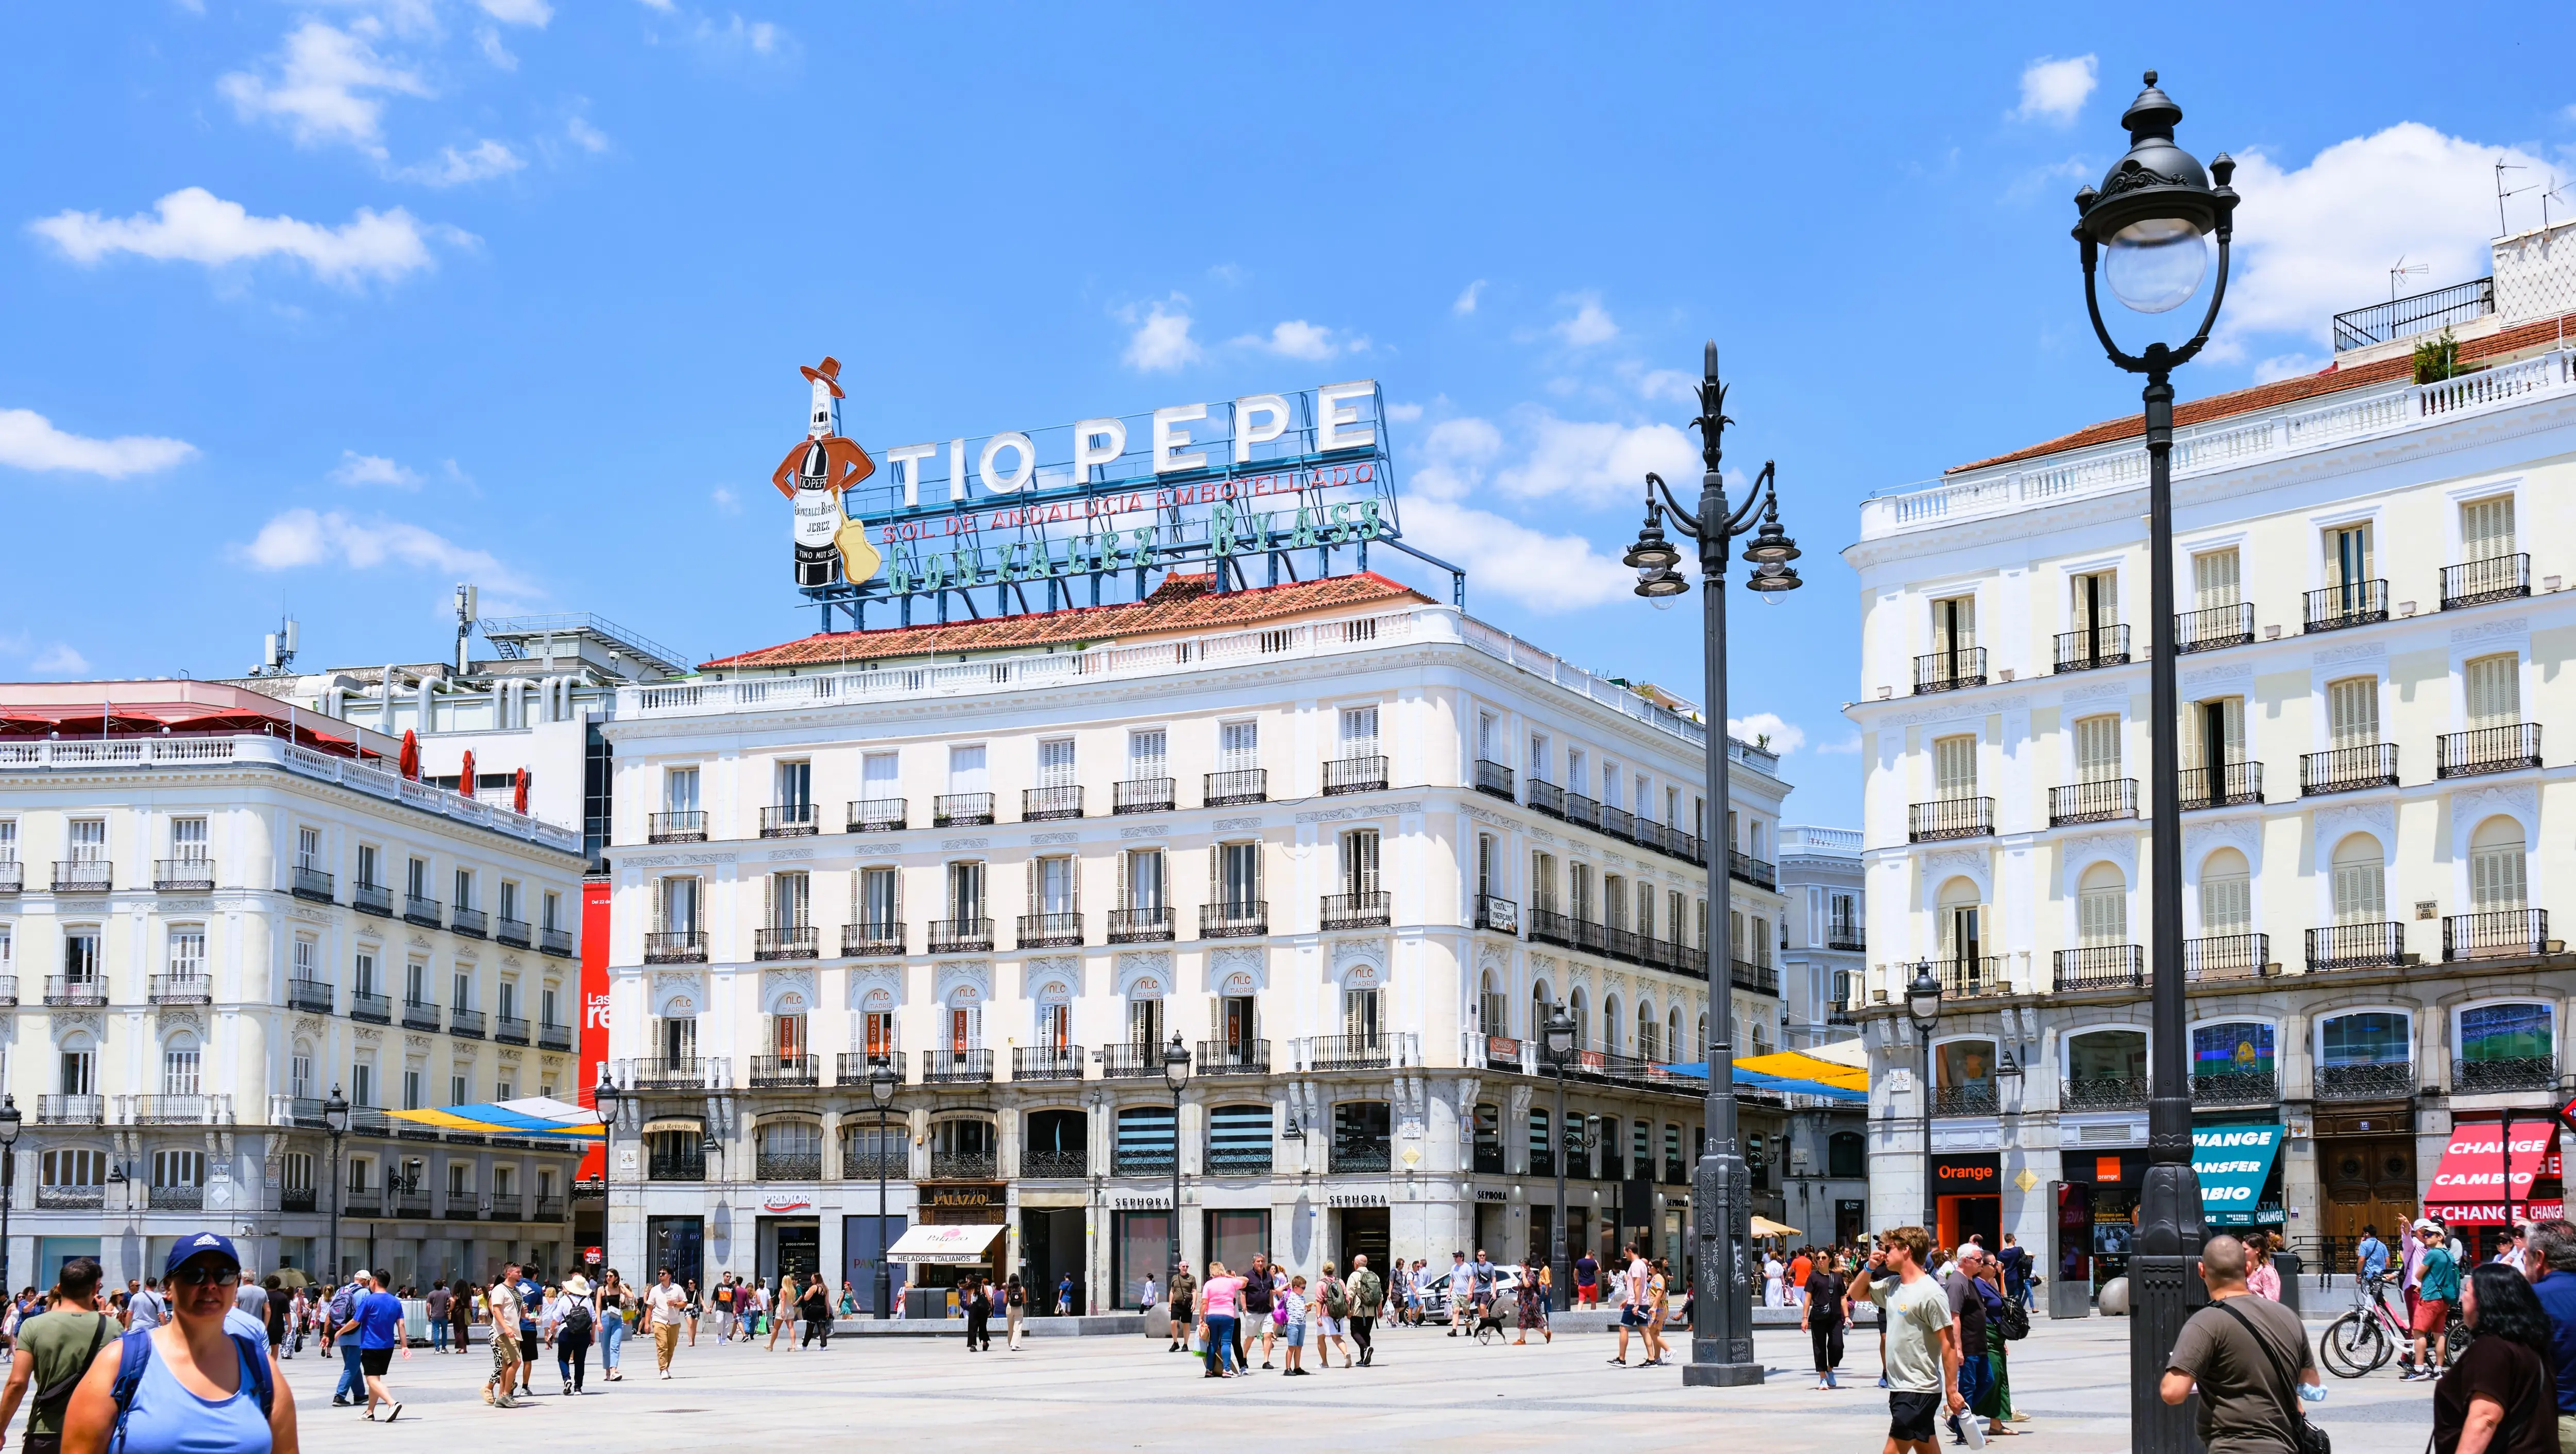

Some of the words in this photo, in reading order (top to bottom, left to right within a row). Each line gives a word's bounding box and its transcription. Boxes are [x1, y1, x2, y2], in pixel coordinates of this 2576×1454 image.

[887, 431, 1036, 506] TIO
[1075, 378, 1376, 484] PEPE
[799, 477, 810, 487] TIO
[883, 521, 936, 544] SOL
[945, 515, 978, 536] DE
[991, 492, 1143, 530] ANDALUCIA
[1156, 462, 1374, 509] EMBOTELLADO
[807, 520, 830, 533] JEREZ
[887, 526, 1156, 596] GONZALEZ
[1211, 497, 1380, 559] BYASS
[799, 550, 813, 560] FINO
[816, 550, 827, 559] MUY
[1494, 902, 1507, 911] HOSTAL
[1493, 911, 1513, 922] AMERICANO
[1495, 1039, 1512, 1049] SPANISH
[2448, 1140, 2546, 1154] CHANGE
[1939, 1165, 1992, 1180] Orange
[765, 1194, 810, 1204] PRIMOR
[934, 1194, 986, 1205] PALAZZO
[1330, 1195, 1386, 1204] SEPHORA
[1477, 1190, 1507, 1200] SEPHORA
[2257, 1211, 2284, 1223] CHANGE
[2530, 1206, 2563, 1219] CHANGE
[854, 1258, 901, 1270] PANTNE
